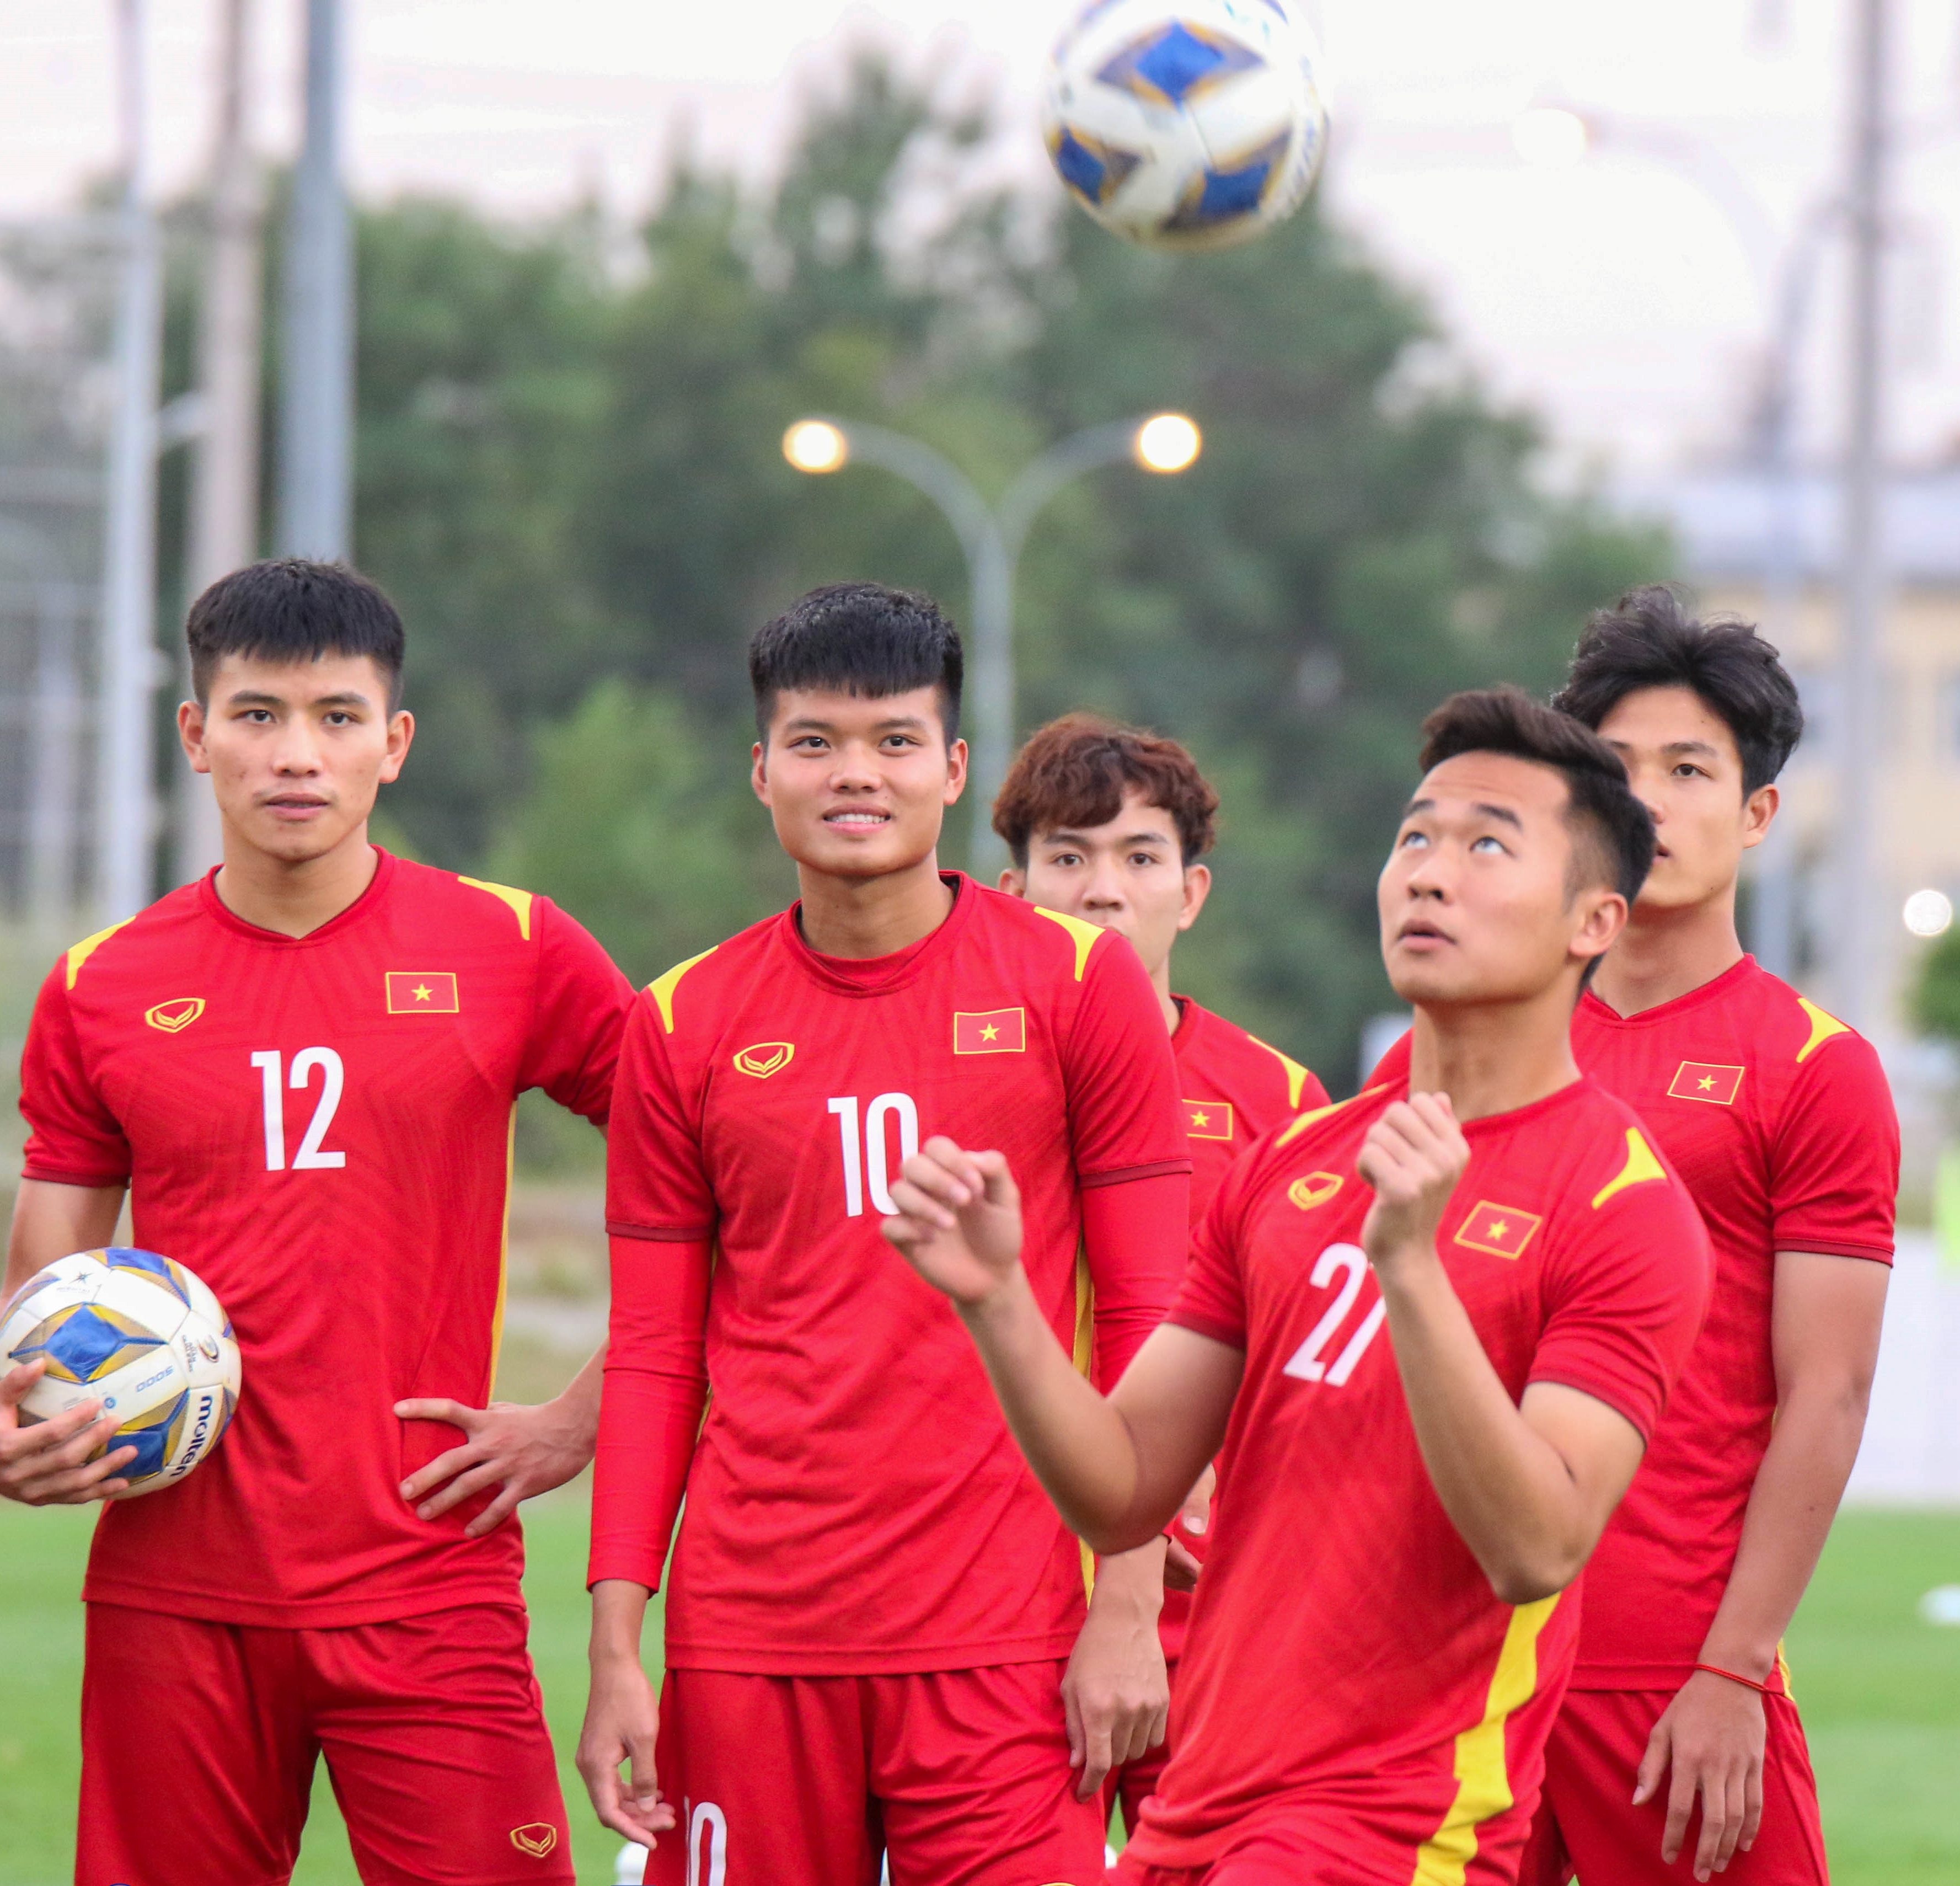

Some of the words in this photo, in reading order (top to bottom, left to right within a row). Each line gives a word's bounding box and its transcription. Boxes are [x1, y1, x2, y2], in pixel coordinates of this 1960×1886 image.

[251, 1046, 346, 1171] 12
[827, 1092, 919, 1217] 10
[170, 1395, 213, 1477] molten
